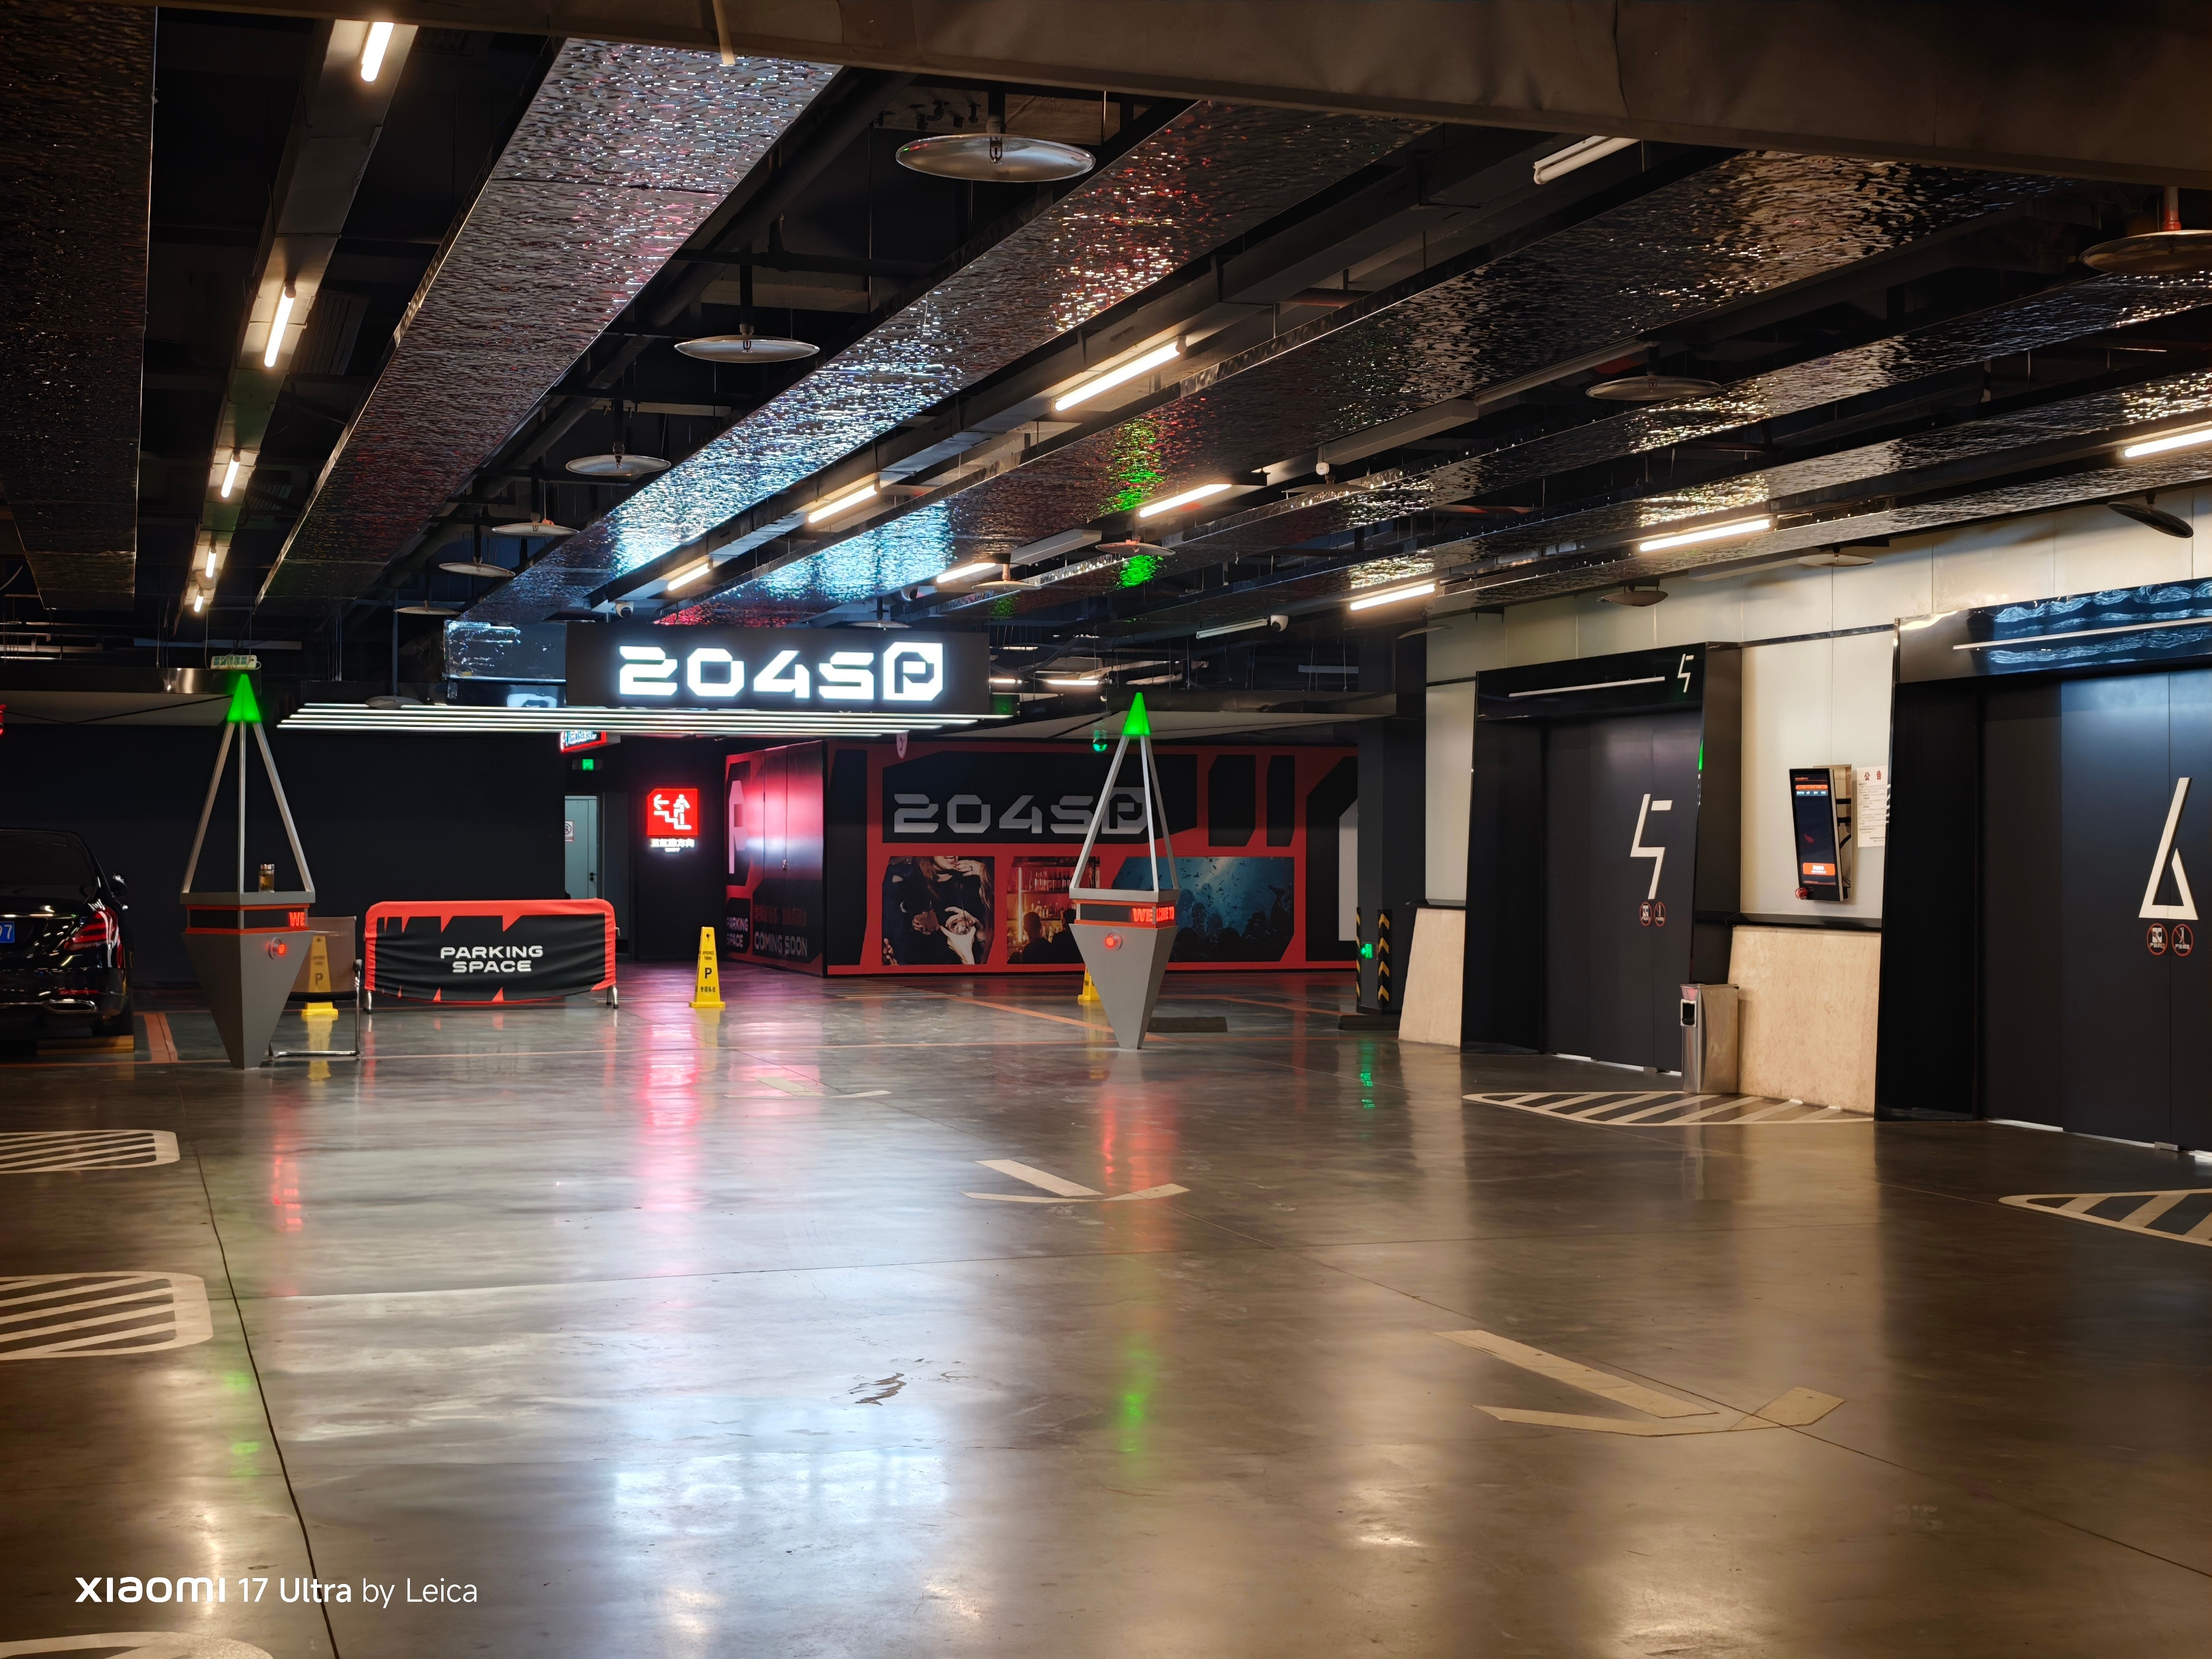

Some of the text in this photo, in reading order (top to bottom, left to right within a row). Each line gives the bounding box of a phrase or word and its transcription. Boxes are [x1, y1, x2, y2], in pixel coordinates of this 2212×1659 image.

[1677, 653, 1694, 693] 5
[1630, 794, 1673, 900] 5
[2139, 777, 2200, 920] 6
[440, 946, 543, 959] PARKING
[754, 931, 807, 957] COMING SOON
[453, 960, 531, 973] SPACE
[705, 967, 712, 979] P
[315, 973, 323, 986] P
